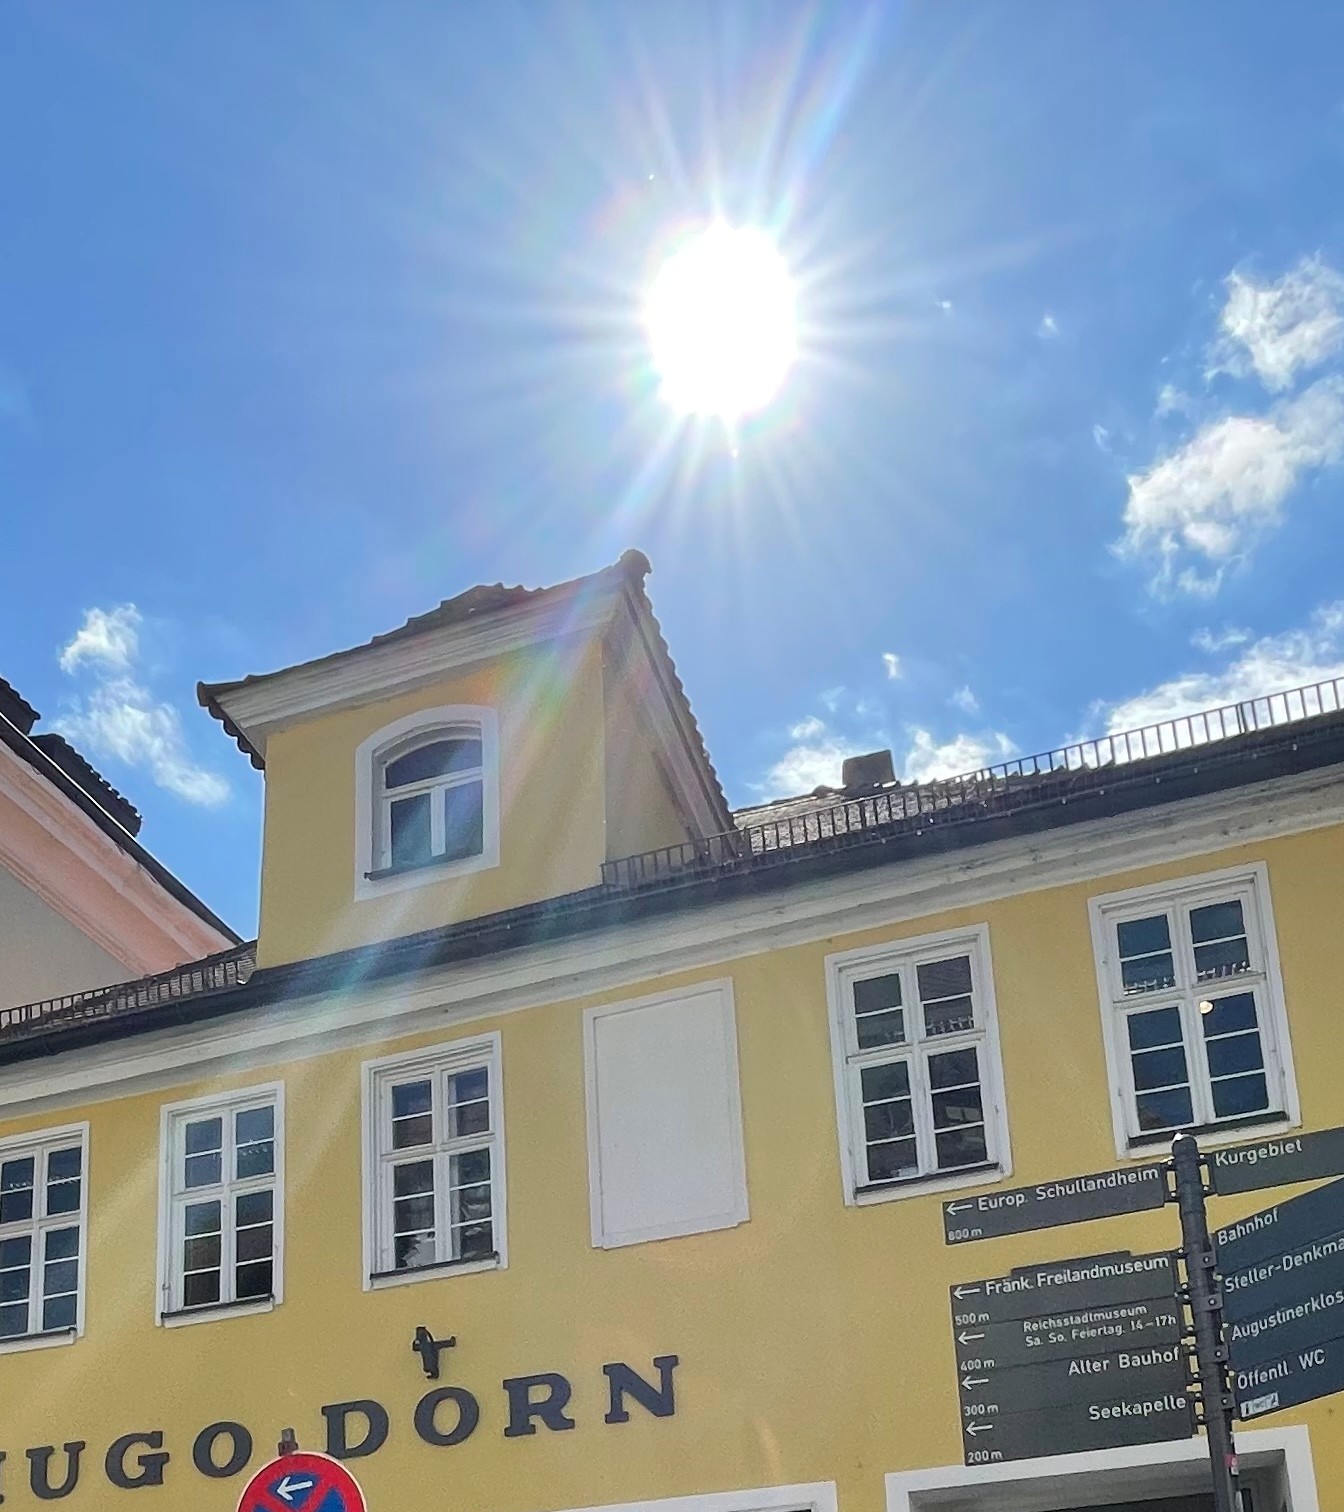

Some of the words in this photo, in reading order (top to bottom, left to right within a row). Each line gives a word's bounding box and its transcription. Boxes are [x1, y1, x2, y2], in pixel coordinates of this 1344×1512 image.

[1215, 1138, 1303, 1167] Kurgebiet
[977, 1193, 1028, 1212] Europ.
[1035, 1167, 1159, 1201] Schullandheim
[948, 1227, 969, 1241] 800
[971, 1226, 983, 1238] m
[1216, 1207, 1279, 1246] Bahnhof
[1036, 1256, 1169, 1289] Freilandmuseum
[955, 1312, 976, 1326] 500
[978, 1311, 990, 1322] m
[1022, 1304, 1148, 1333] Reichsstadtmuseum
[1025, 1334, 1044, 1347] Sa.
[1048, 1329, 1067, 1344] So.
[960, 1358, 981, 1372] 400
[983, 1357, 995, 1369] m
[1067, 1358, 1110, 1376] Alter
[1118, 1346, 1180, 1369] Bauhof
[1298, 1348, 1326, 1371] WC
[321, 1354, 679, 1460] DORN
[964, 1404, 985, 1417] 300
[987, 1403, 999, 1414] m
[1088, 1394, 1186, 1421] Seekapelle
[968, 1450, 989, 1464] 200
[990, 1449, 1003, 1461] m
